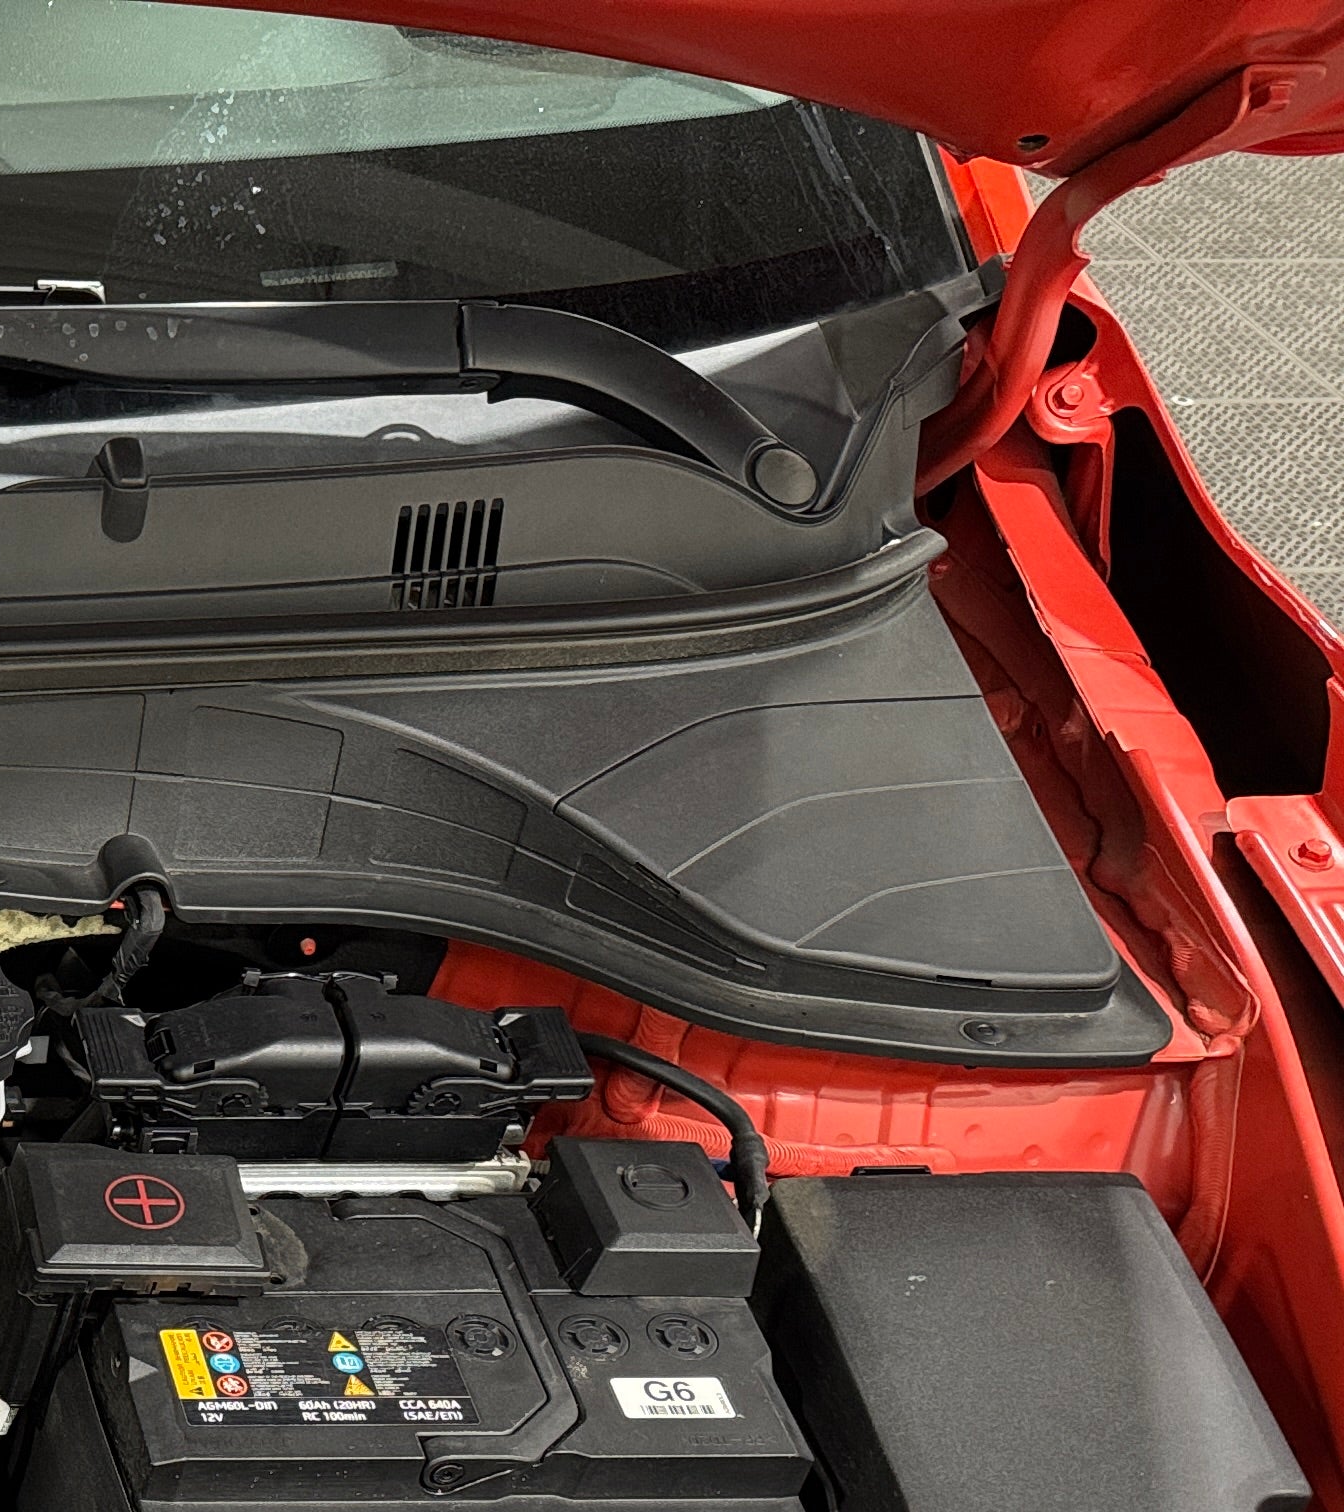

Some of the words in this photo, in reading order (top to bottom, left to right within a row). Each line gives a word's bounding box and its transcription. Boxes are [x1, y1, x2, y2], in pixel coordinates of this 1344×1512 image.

[643, 1380, 696, 1402] G6
[399, 1400, 427, 1410] CCA
[201, 1412, 224, 1423] 12V
[302, 1412, 322, 1422] RC
